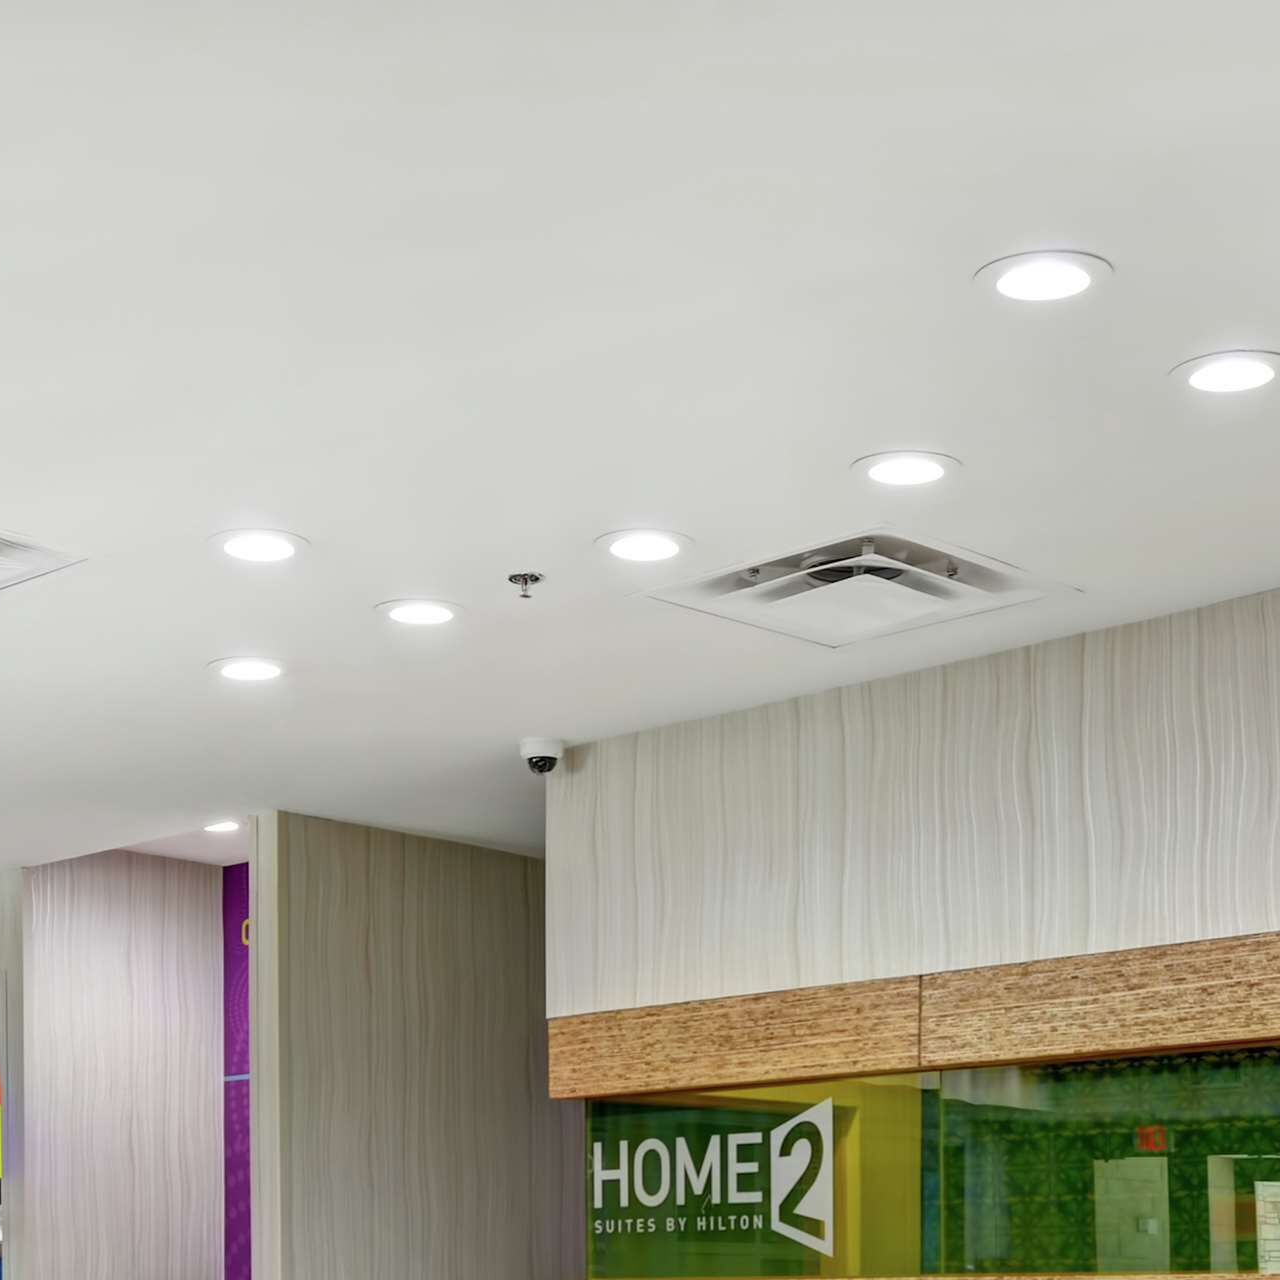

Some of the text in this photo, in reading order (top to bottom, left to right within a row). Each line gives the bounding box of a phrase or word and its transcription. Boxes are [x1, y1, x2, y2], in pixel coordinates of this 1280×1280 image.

[593, 1214, 763, 1234] SUITES BY HILTON
